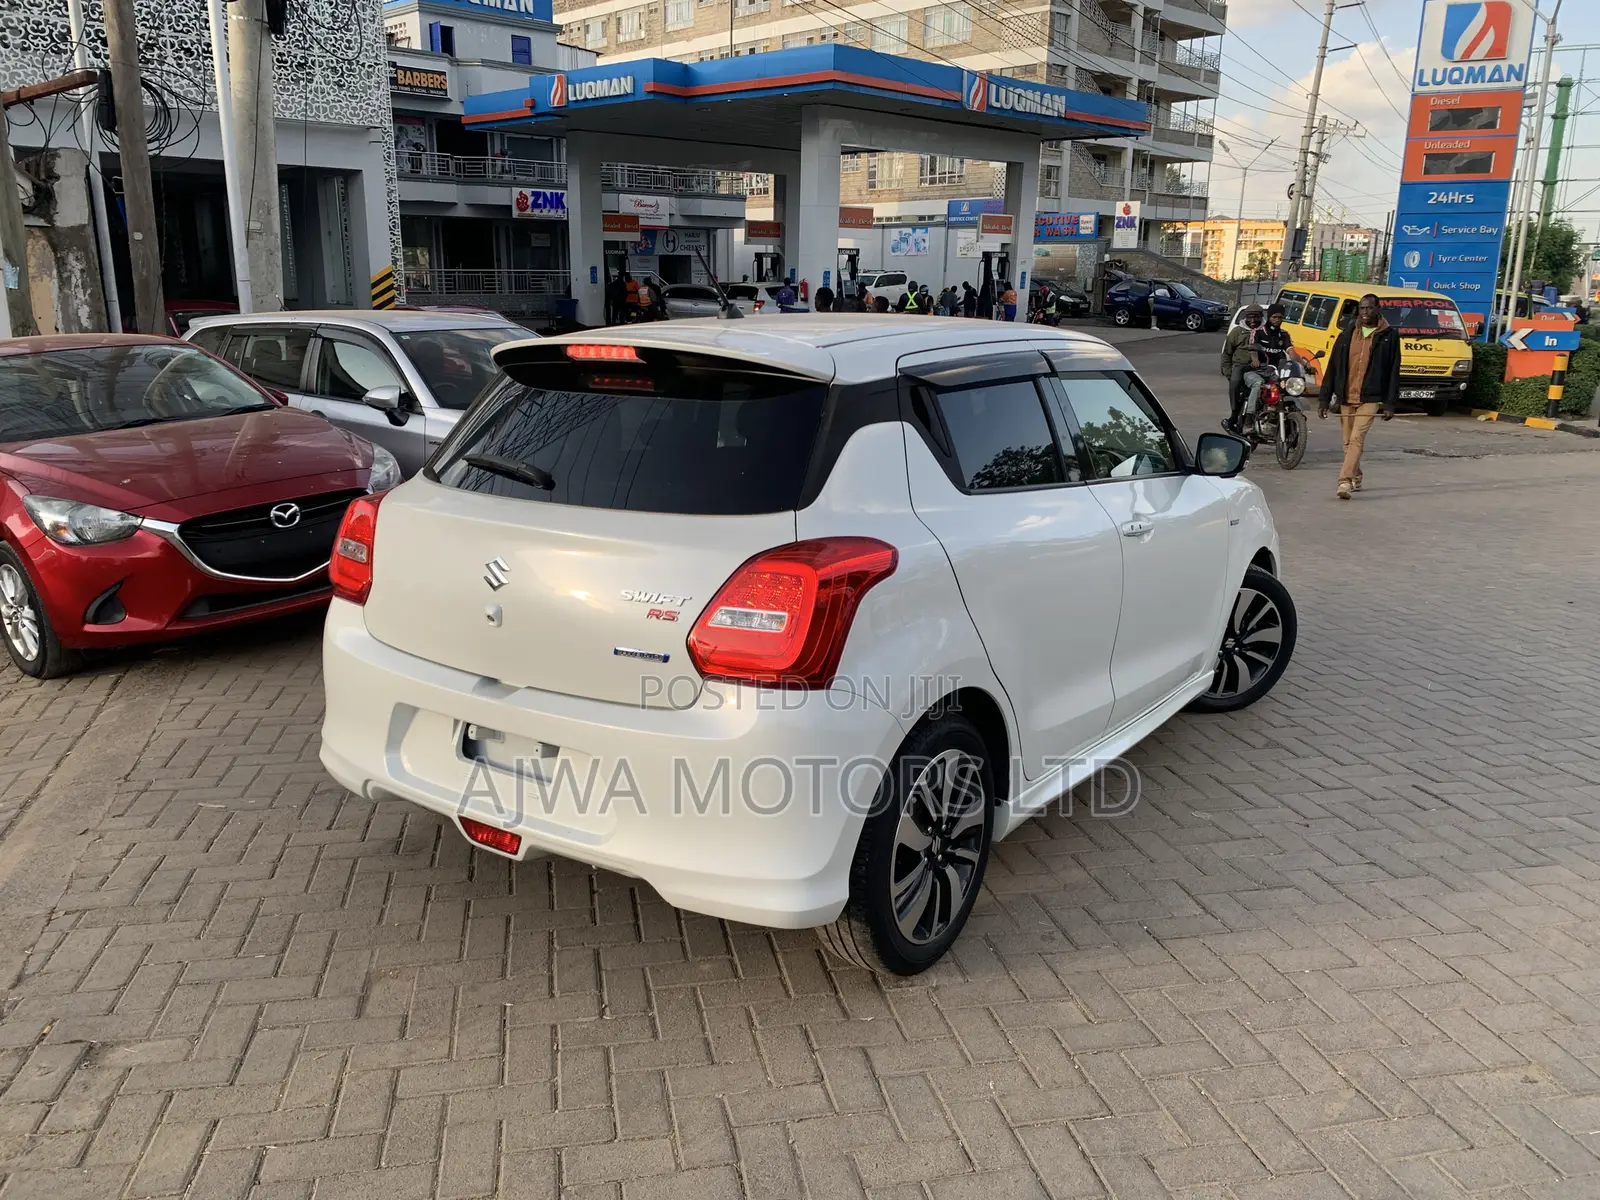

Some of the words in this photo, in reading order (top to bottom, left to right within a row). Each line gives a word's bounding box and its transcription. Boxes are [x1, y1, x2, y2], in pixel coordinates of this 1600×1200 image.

[397, 69, 447, 89] BARBERS
[1417, 63, 1525, 86] LUQMAN
[568, 75, 634, 101] LUQMAN
[989, 83, 1066, 117] LUQMAN
[1430, 96, 1461, 106] Diesel
[1424, 140, 1471, 149] Unleaded
[530, 190, 566, 209] ZNK
[1427, 191, 1475, 205] 24Hrs
[1115, 216, 1137, 229] ZNK
[1046, 227, 1078, 237] WASH
[1441, 226, 1477, 234] Service
[1479, 226, 1498, 236] Bay
[1437, 254, 1458, 263] Tyre
[1459, 254, 1489, 262] Center
[1433, 282, 1457, 290] Quick
[1459, 282, 1481, 291] Shop
[1379, 299, 1454, 309] IVERPOOL
[1544, 335, 1557, 346] In
[619, 589, 693, 607] SWIFT
[645, 608, 681, 622] RS
